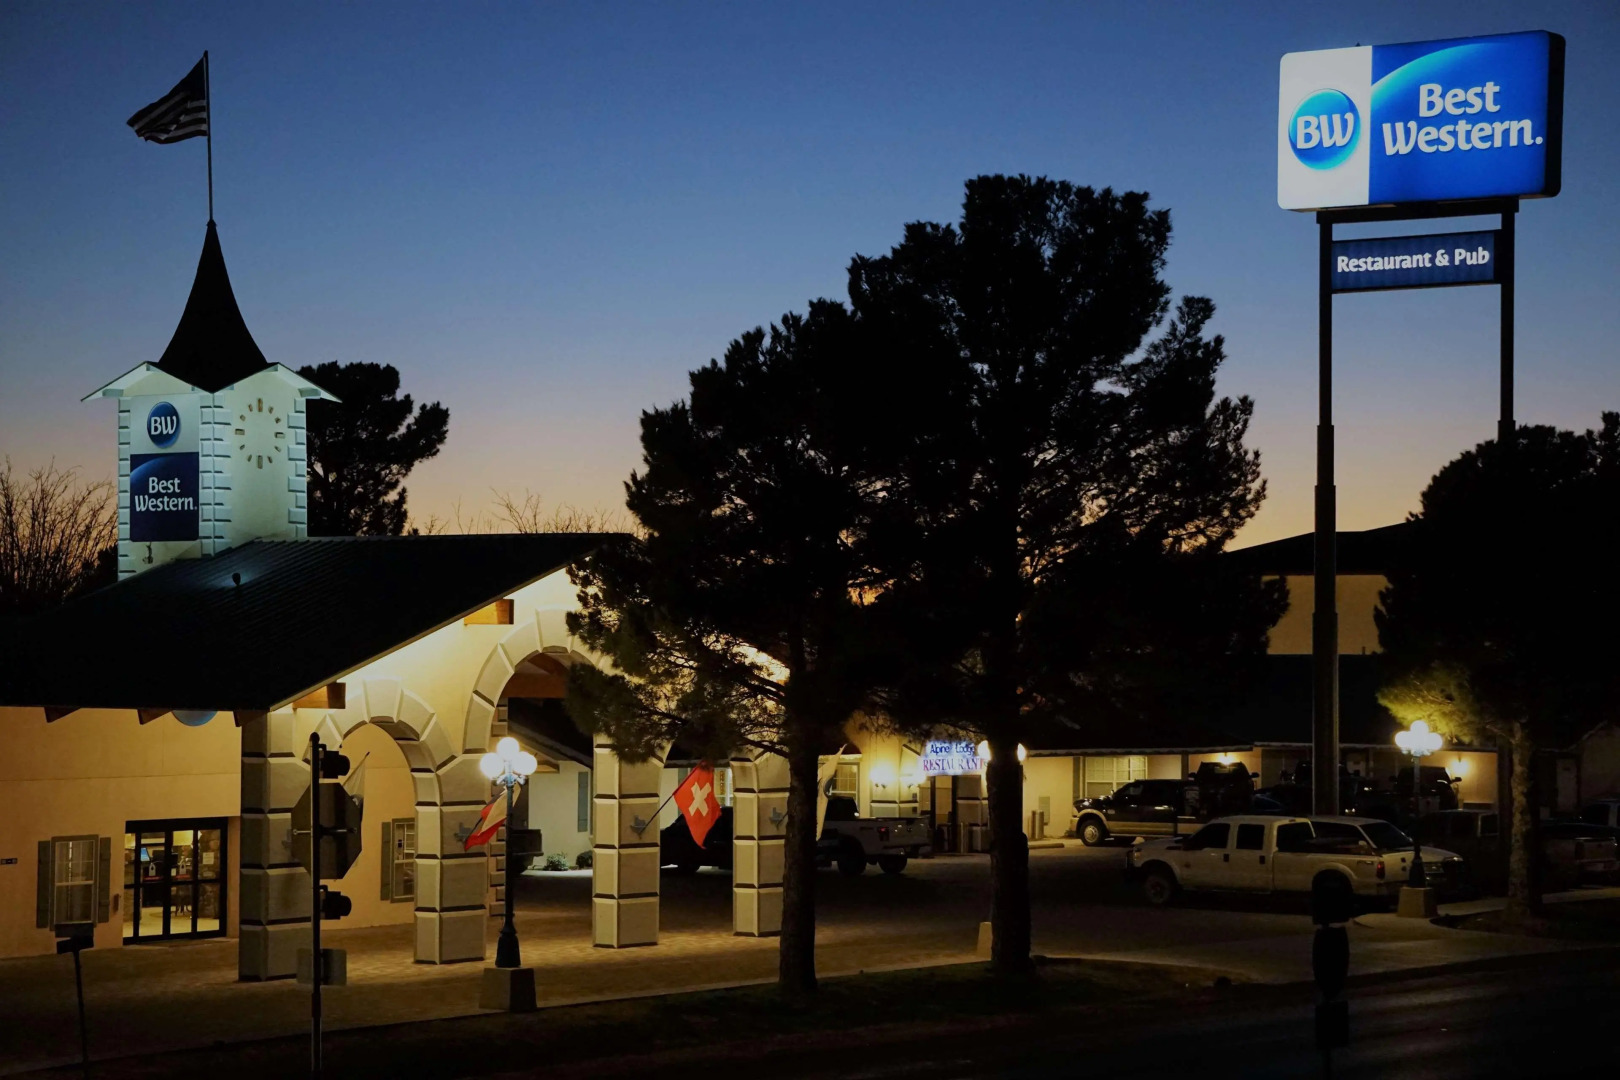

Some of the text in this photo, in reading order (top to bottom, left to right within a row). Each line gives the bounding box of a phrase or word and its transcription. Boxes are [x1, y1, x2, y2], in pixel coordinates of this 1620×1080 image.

[1419, 81, 1500, 118] Best
[1296, 110, 1355, 150] BW
[1337, 246, 1490, 273] Restaurant & Pub
[150, 415, 176, 436] BW
[148, 476, 181, 494] Best
[930, 743, 975, 756] Alpine Lodge
